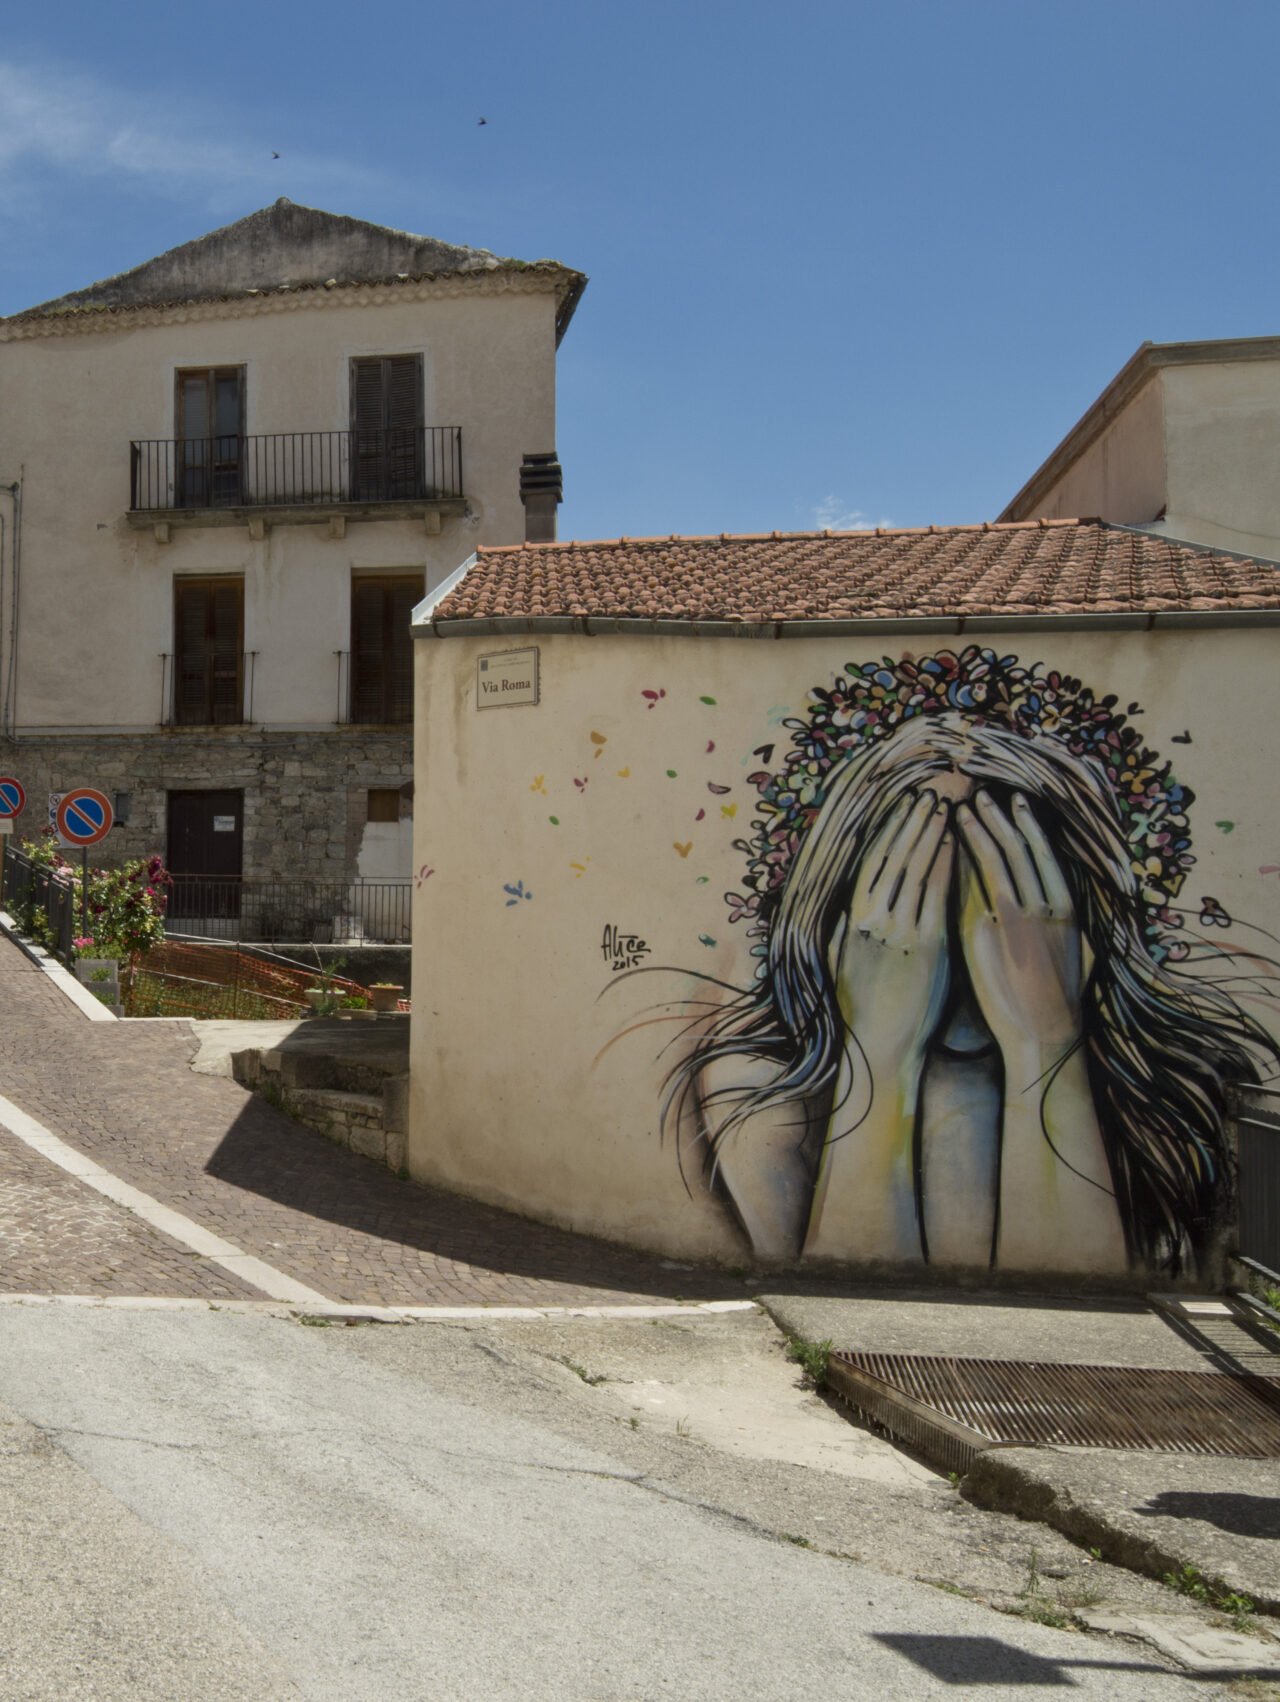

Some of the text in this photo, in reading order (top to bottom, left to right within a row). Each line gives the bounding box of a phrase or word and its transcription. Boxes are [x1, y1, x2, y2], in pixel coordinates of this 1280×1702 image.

[481, 679, 532, 694] Via Roma
[612, 954, 645, 971] 2015
